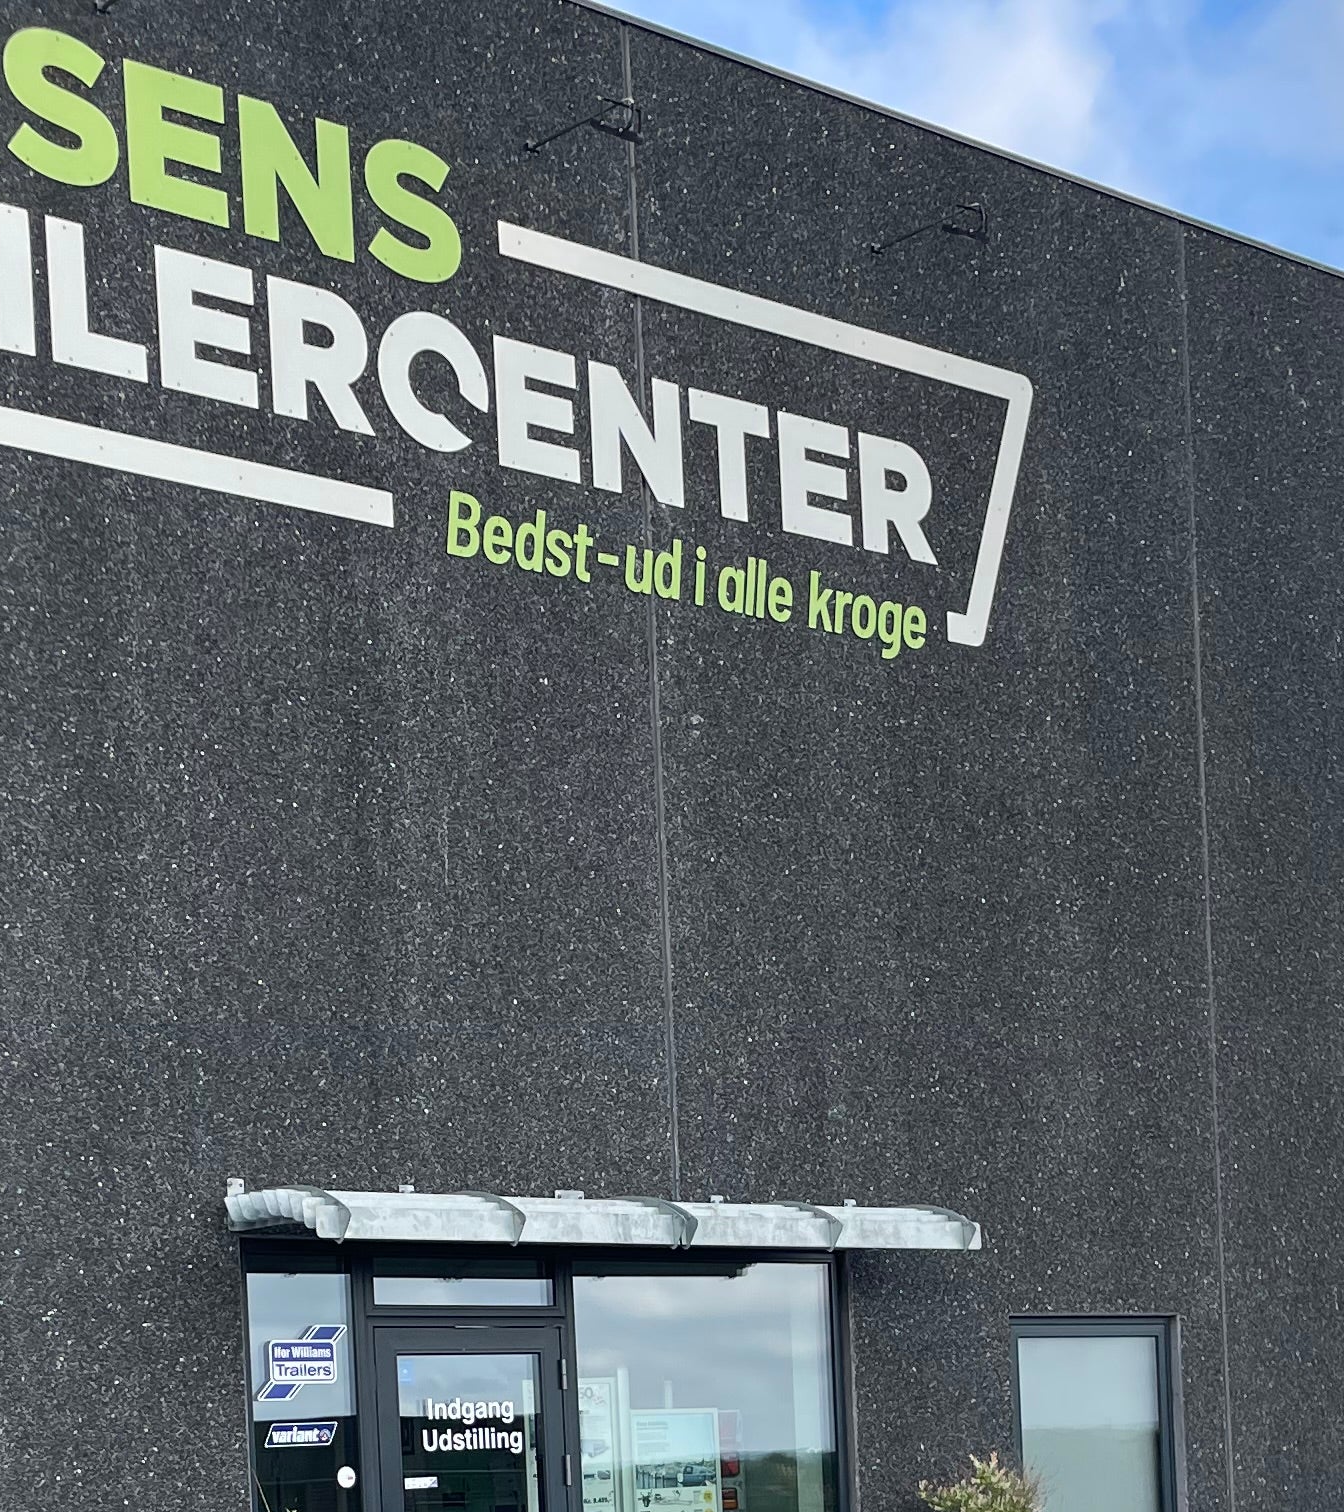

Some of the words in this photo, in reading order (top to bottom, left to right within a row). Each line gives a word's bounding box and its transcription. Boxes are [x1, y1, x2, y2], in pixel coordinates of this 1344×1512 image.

[446, 490, 682, 600] Bedst-ud
[694, 546, 707, 607] i
[718, 556, 793, 623] alle
[808, 570, 927, 660] kroge
[274, 1346, 290, 1358] Ifor
[291, 1346, 331, 1358] Williams
[276, 1363, 332, 1377] Trailers
[427, 1398, 514, 1424] Indgang
[272, 1425, 320, 1444] variant
[422, 1427, 523, 1454] Udstilling
